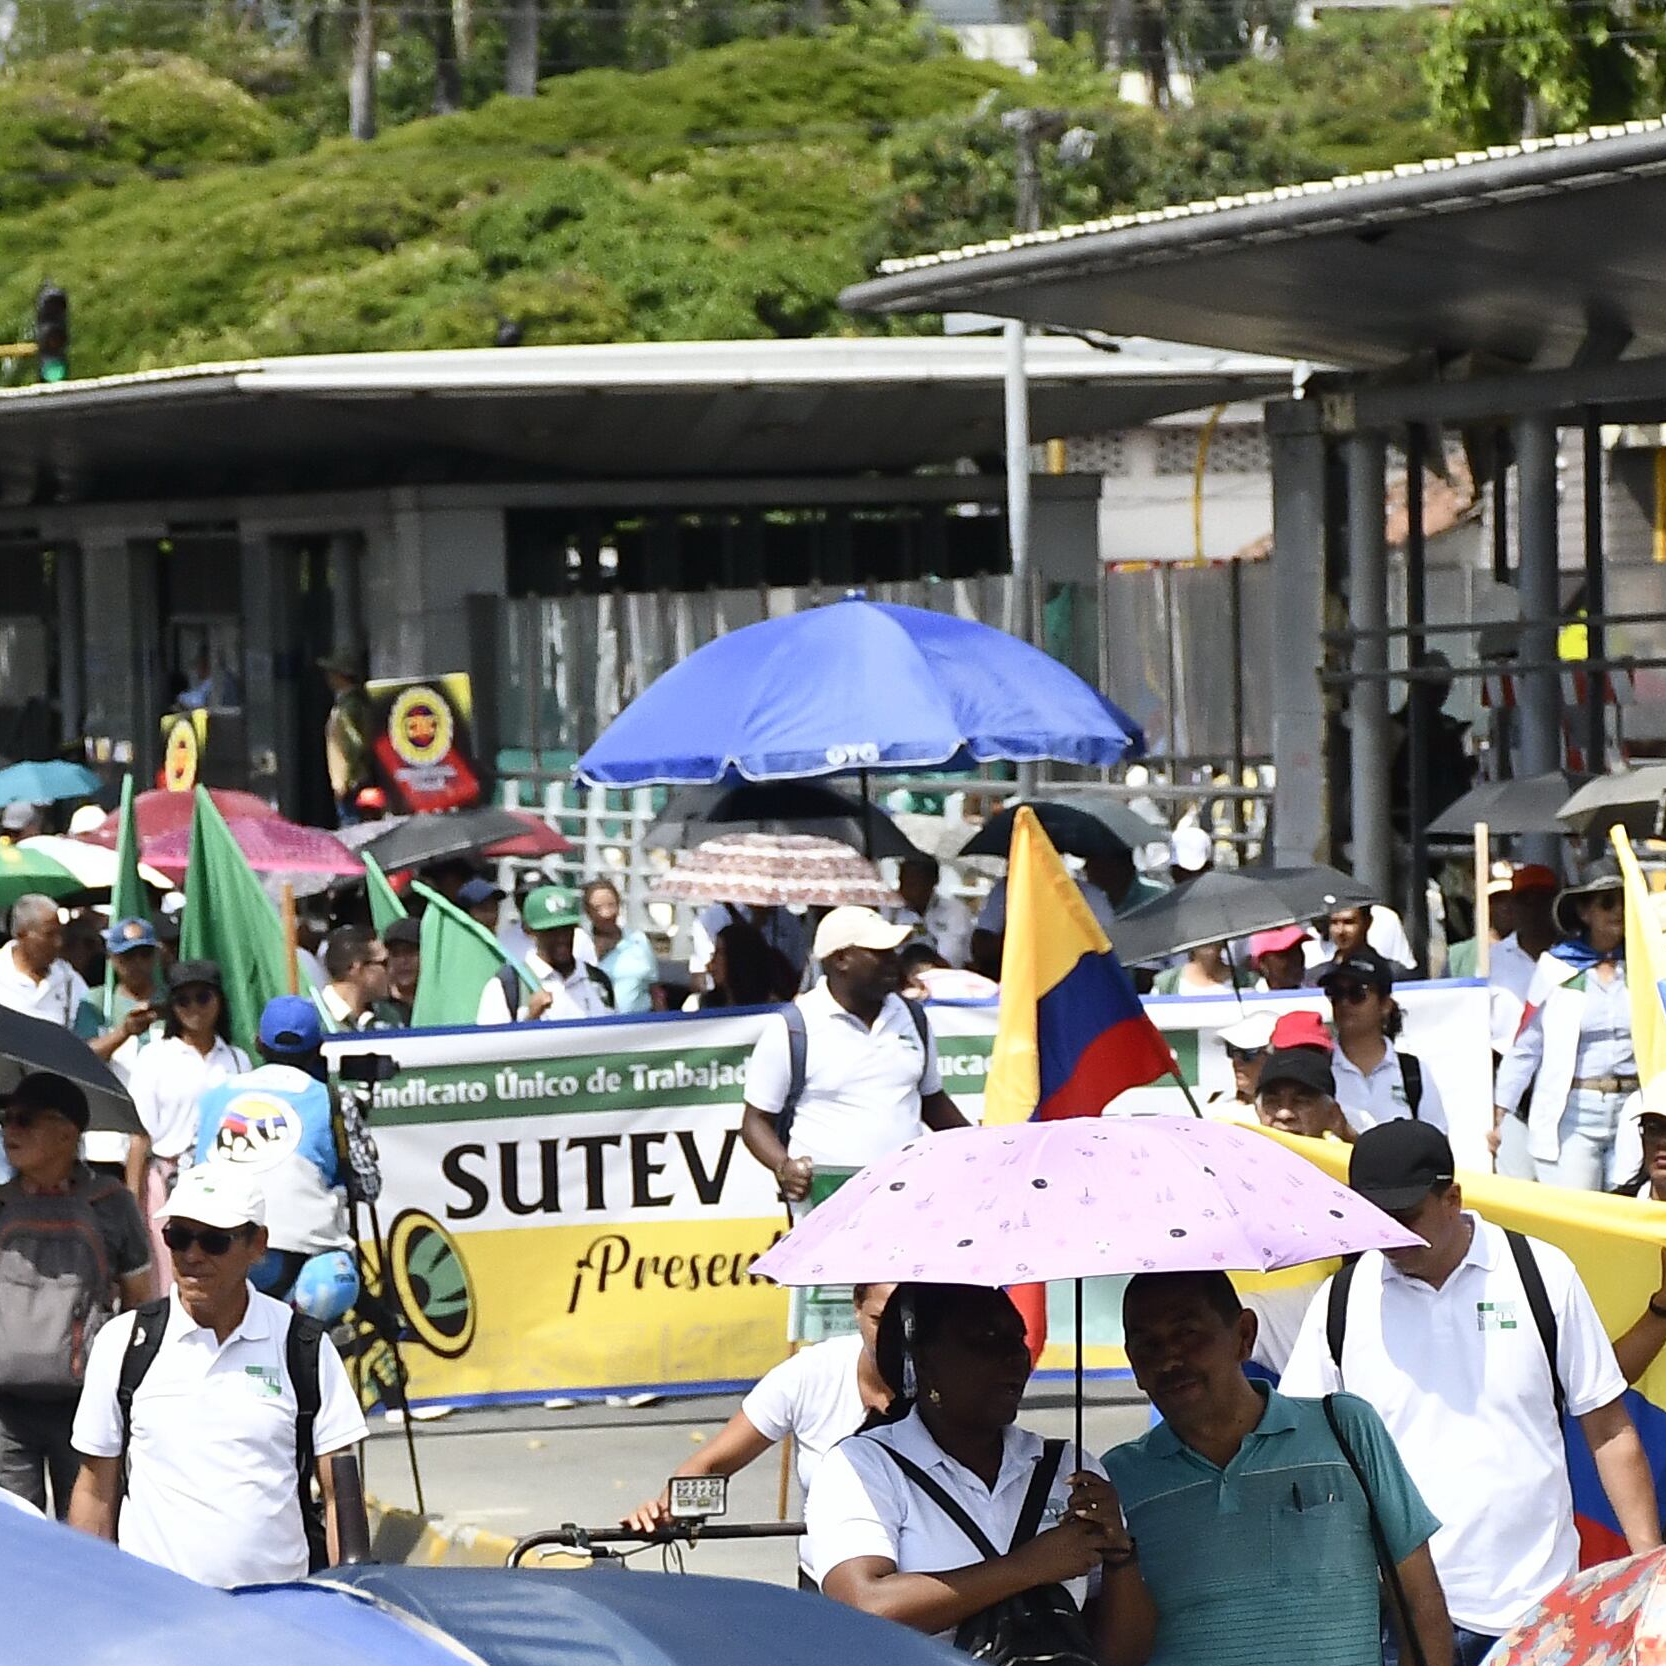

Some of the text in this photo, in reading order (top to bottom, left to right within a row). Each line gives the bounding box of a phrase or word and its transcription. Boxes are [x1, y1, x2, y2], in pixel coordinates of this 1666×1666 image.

[494, 1067, 578, 1100] Único
[586, 1068, 622, 1093] de
[442, 1129, 743, 1220] SUTEV
[567, 1234, 782, 1314] ¡Presen
